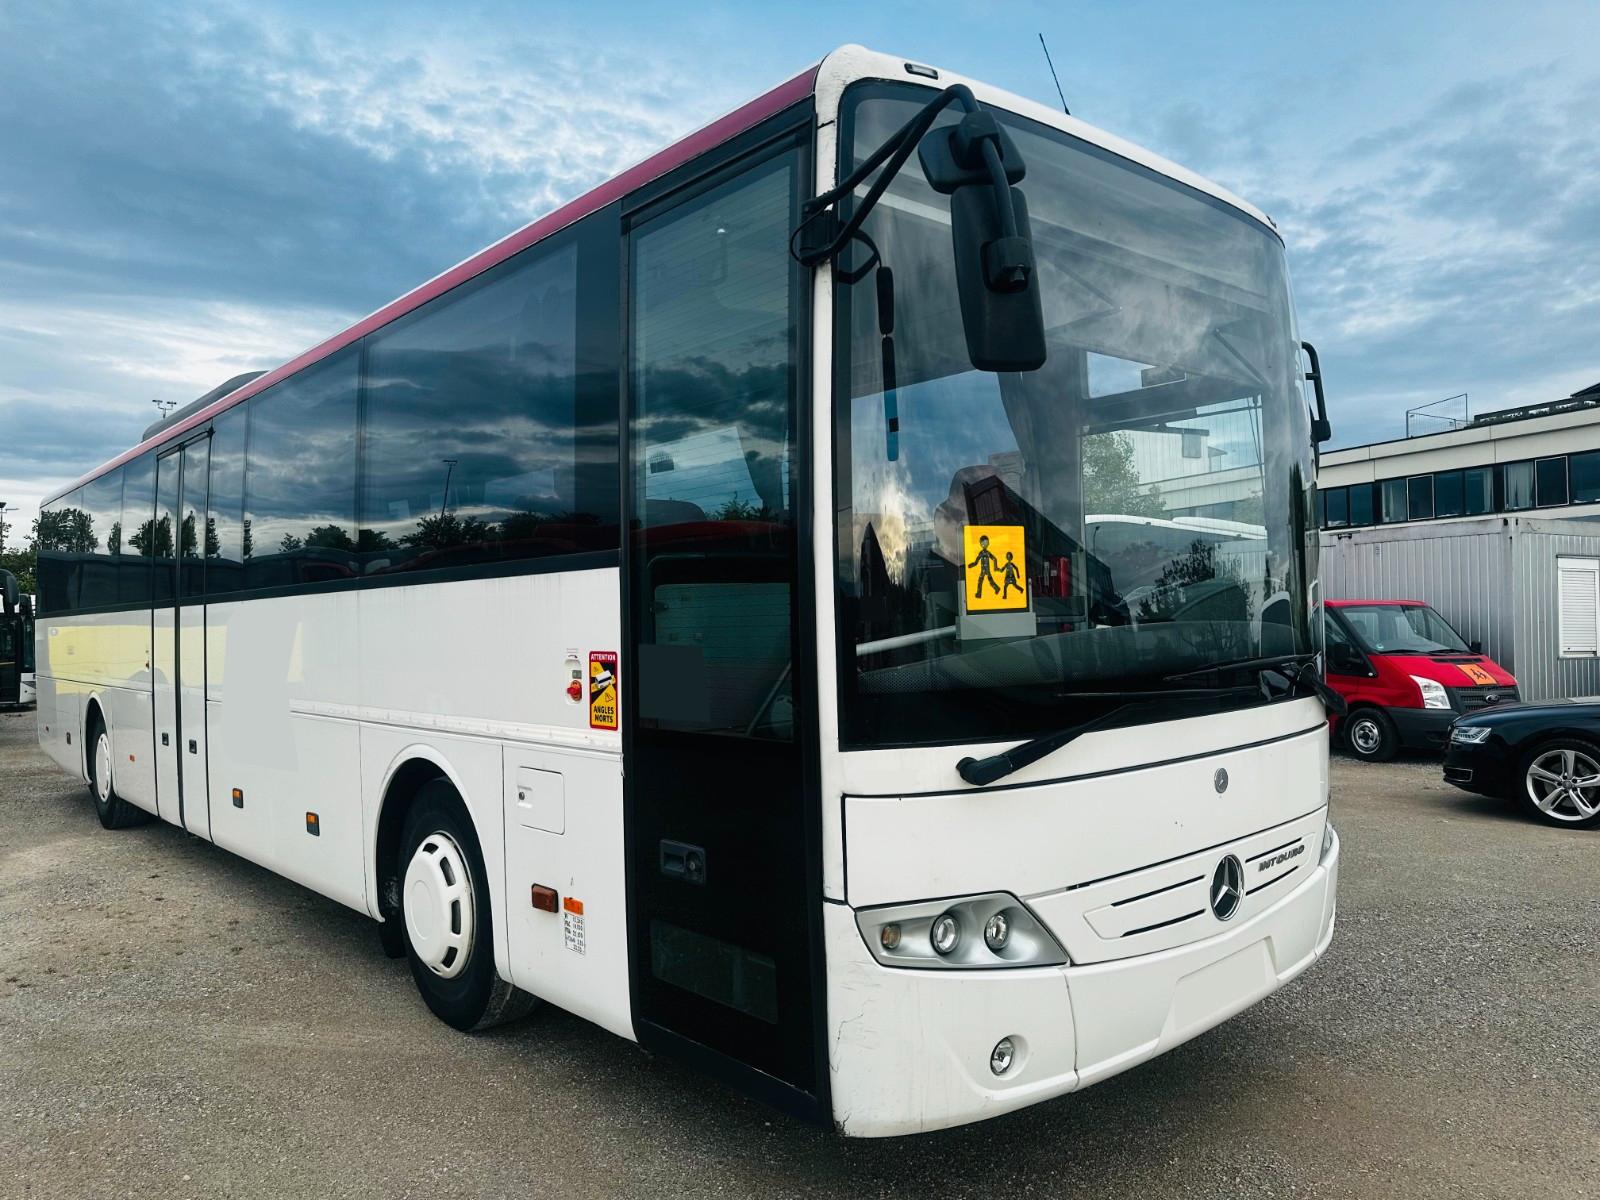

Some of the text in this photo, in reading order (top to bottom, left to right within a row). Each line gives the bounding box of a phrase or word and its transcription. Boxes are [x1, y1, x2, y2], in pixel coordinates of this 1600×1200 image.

[591, 653, 616, 661] ATTENTION
[593, 705, 614, 715] ANGLES
[594, 714, 613, 723] MORTS
[1258, 844, 1305, 872] INTOURO
